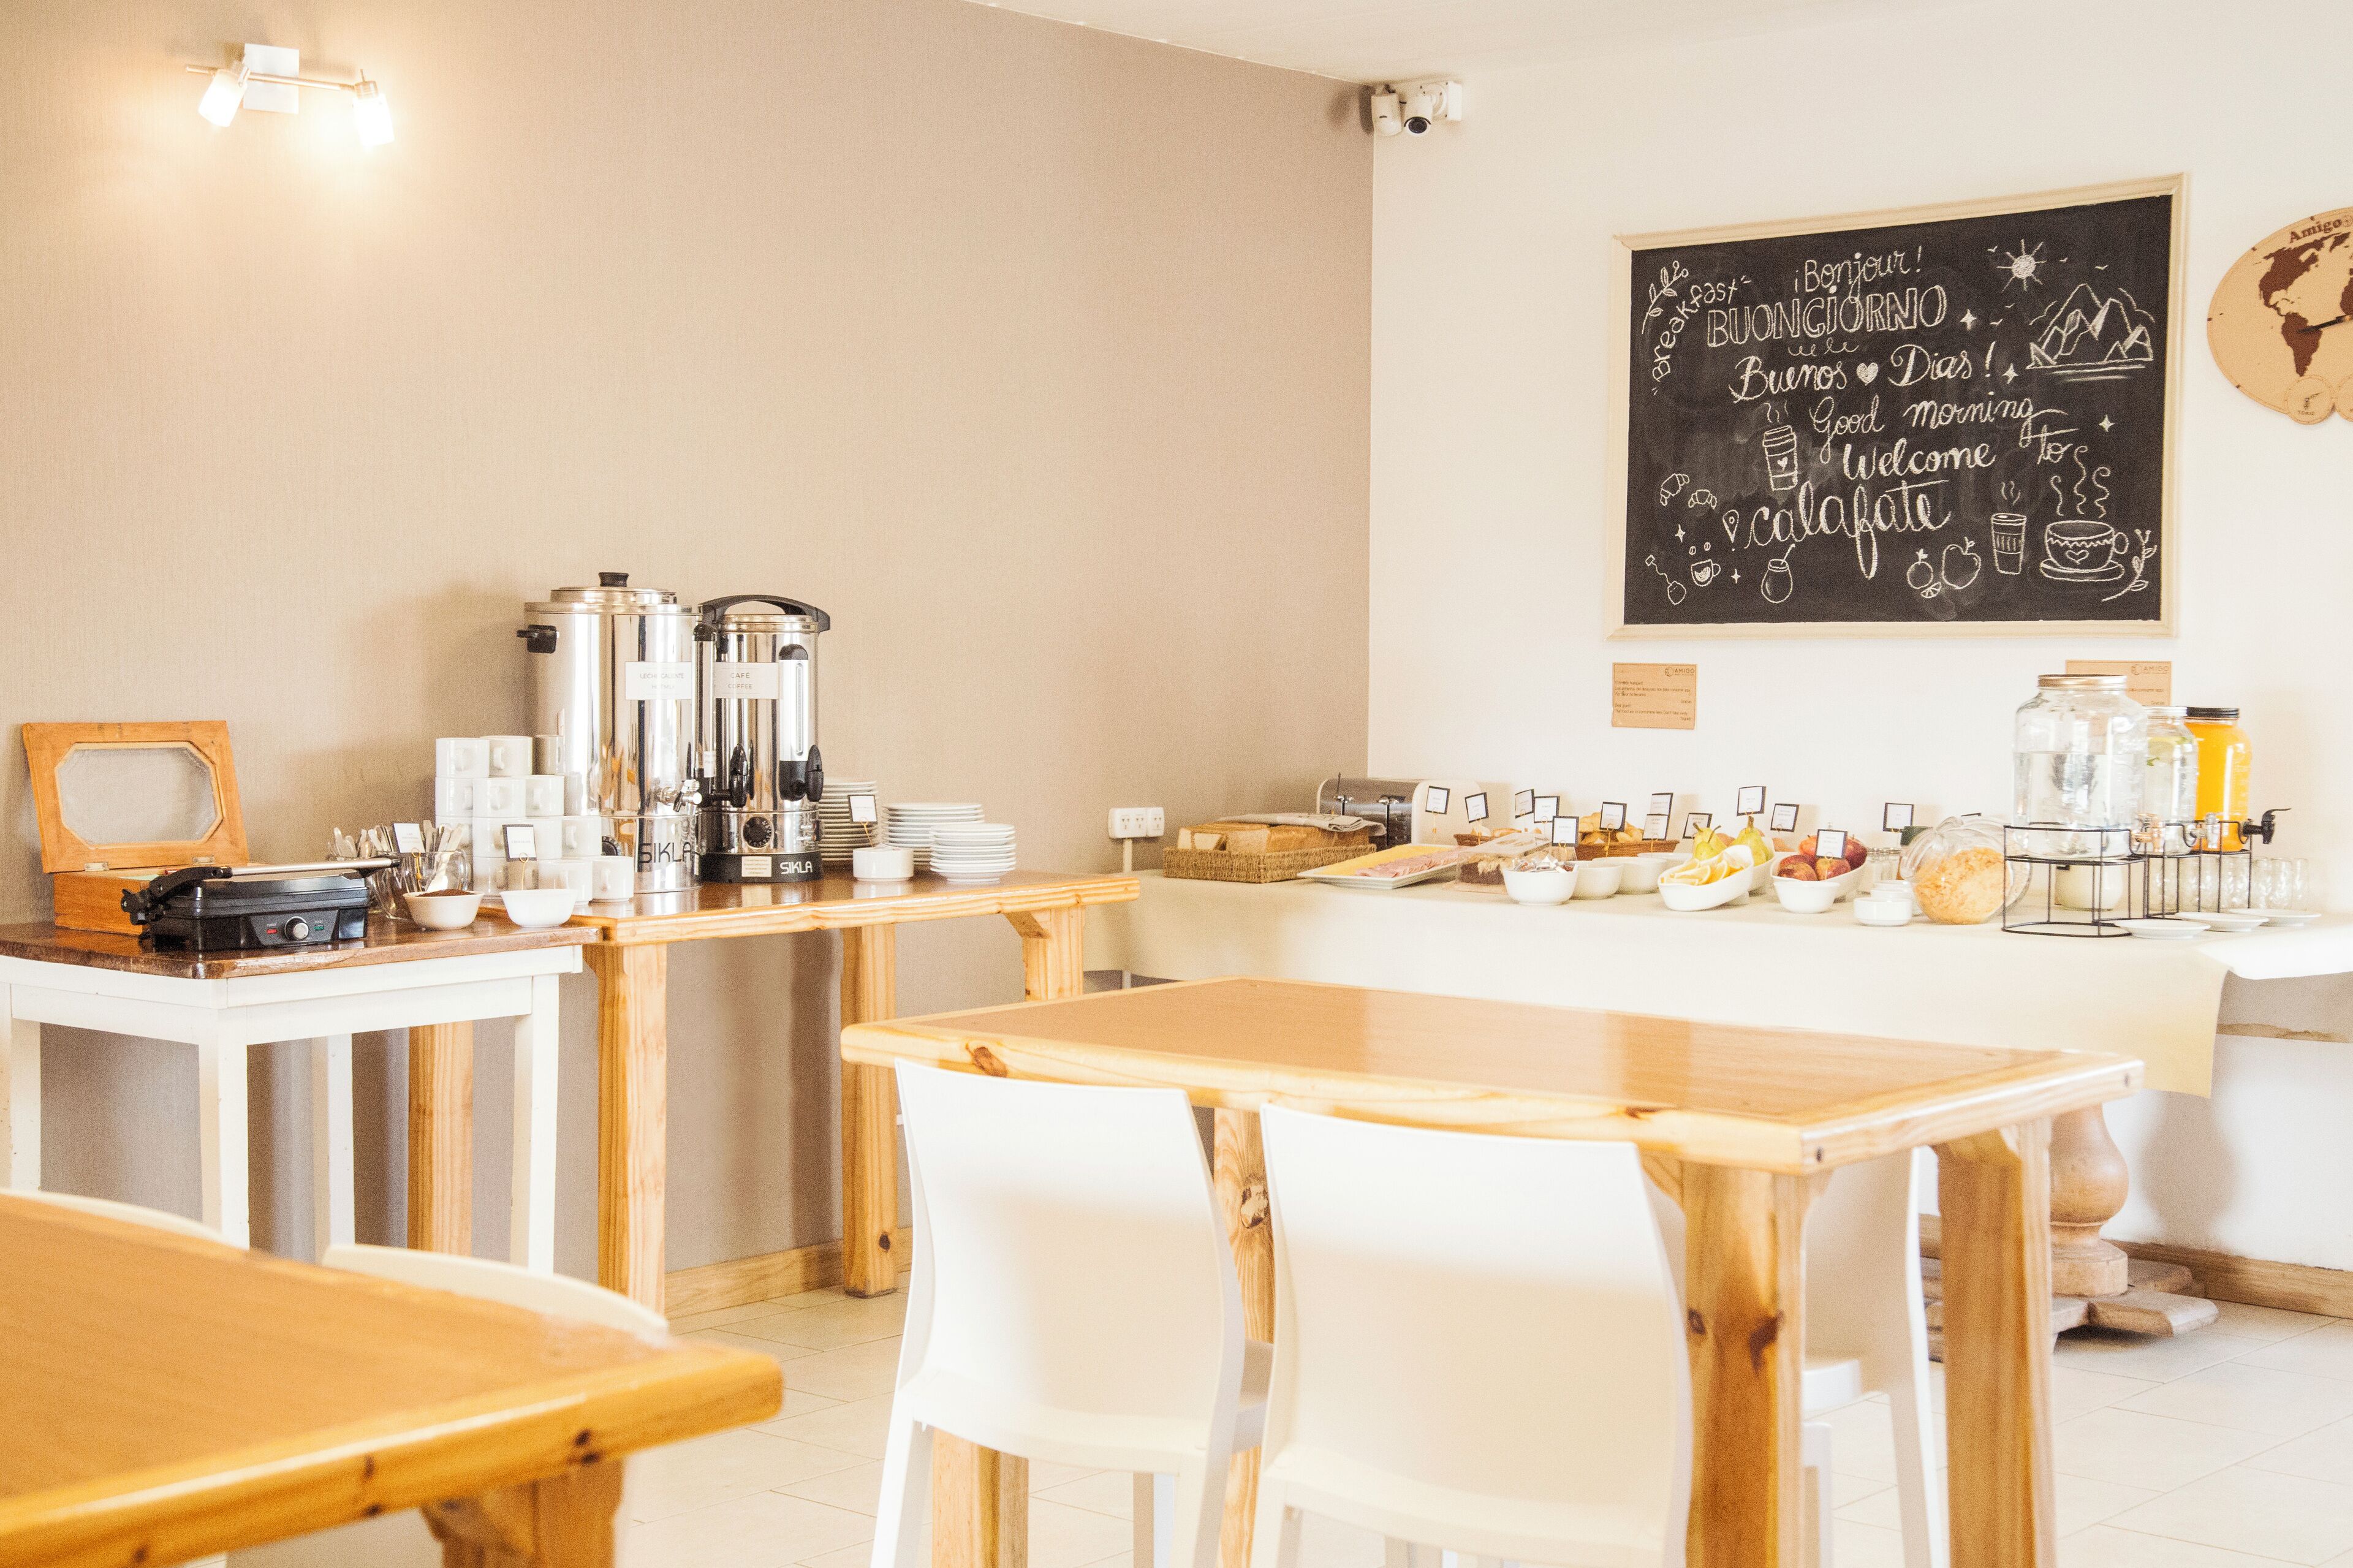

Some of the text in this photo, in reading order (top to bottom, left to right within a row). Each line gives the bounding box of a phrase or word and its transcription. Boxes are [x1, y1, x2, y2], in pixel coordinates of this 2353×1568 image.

[2289, 219, 2343, 244] Amigo
[1729, 355, 1847, 403] Buenos
[1810, 393, 1884, 464] Good
[639, 841, 692, 863] SIKLA
[779, 861, 813, 875] SIKLA
